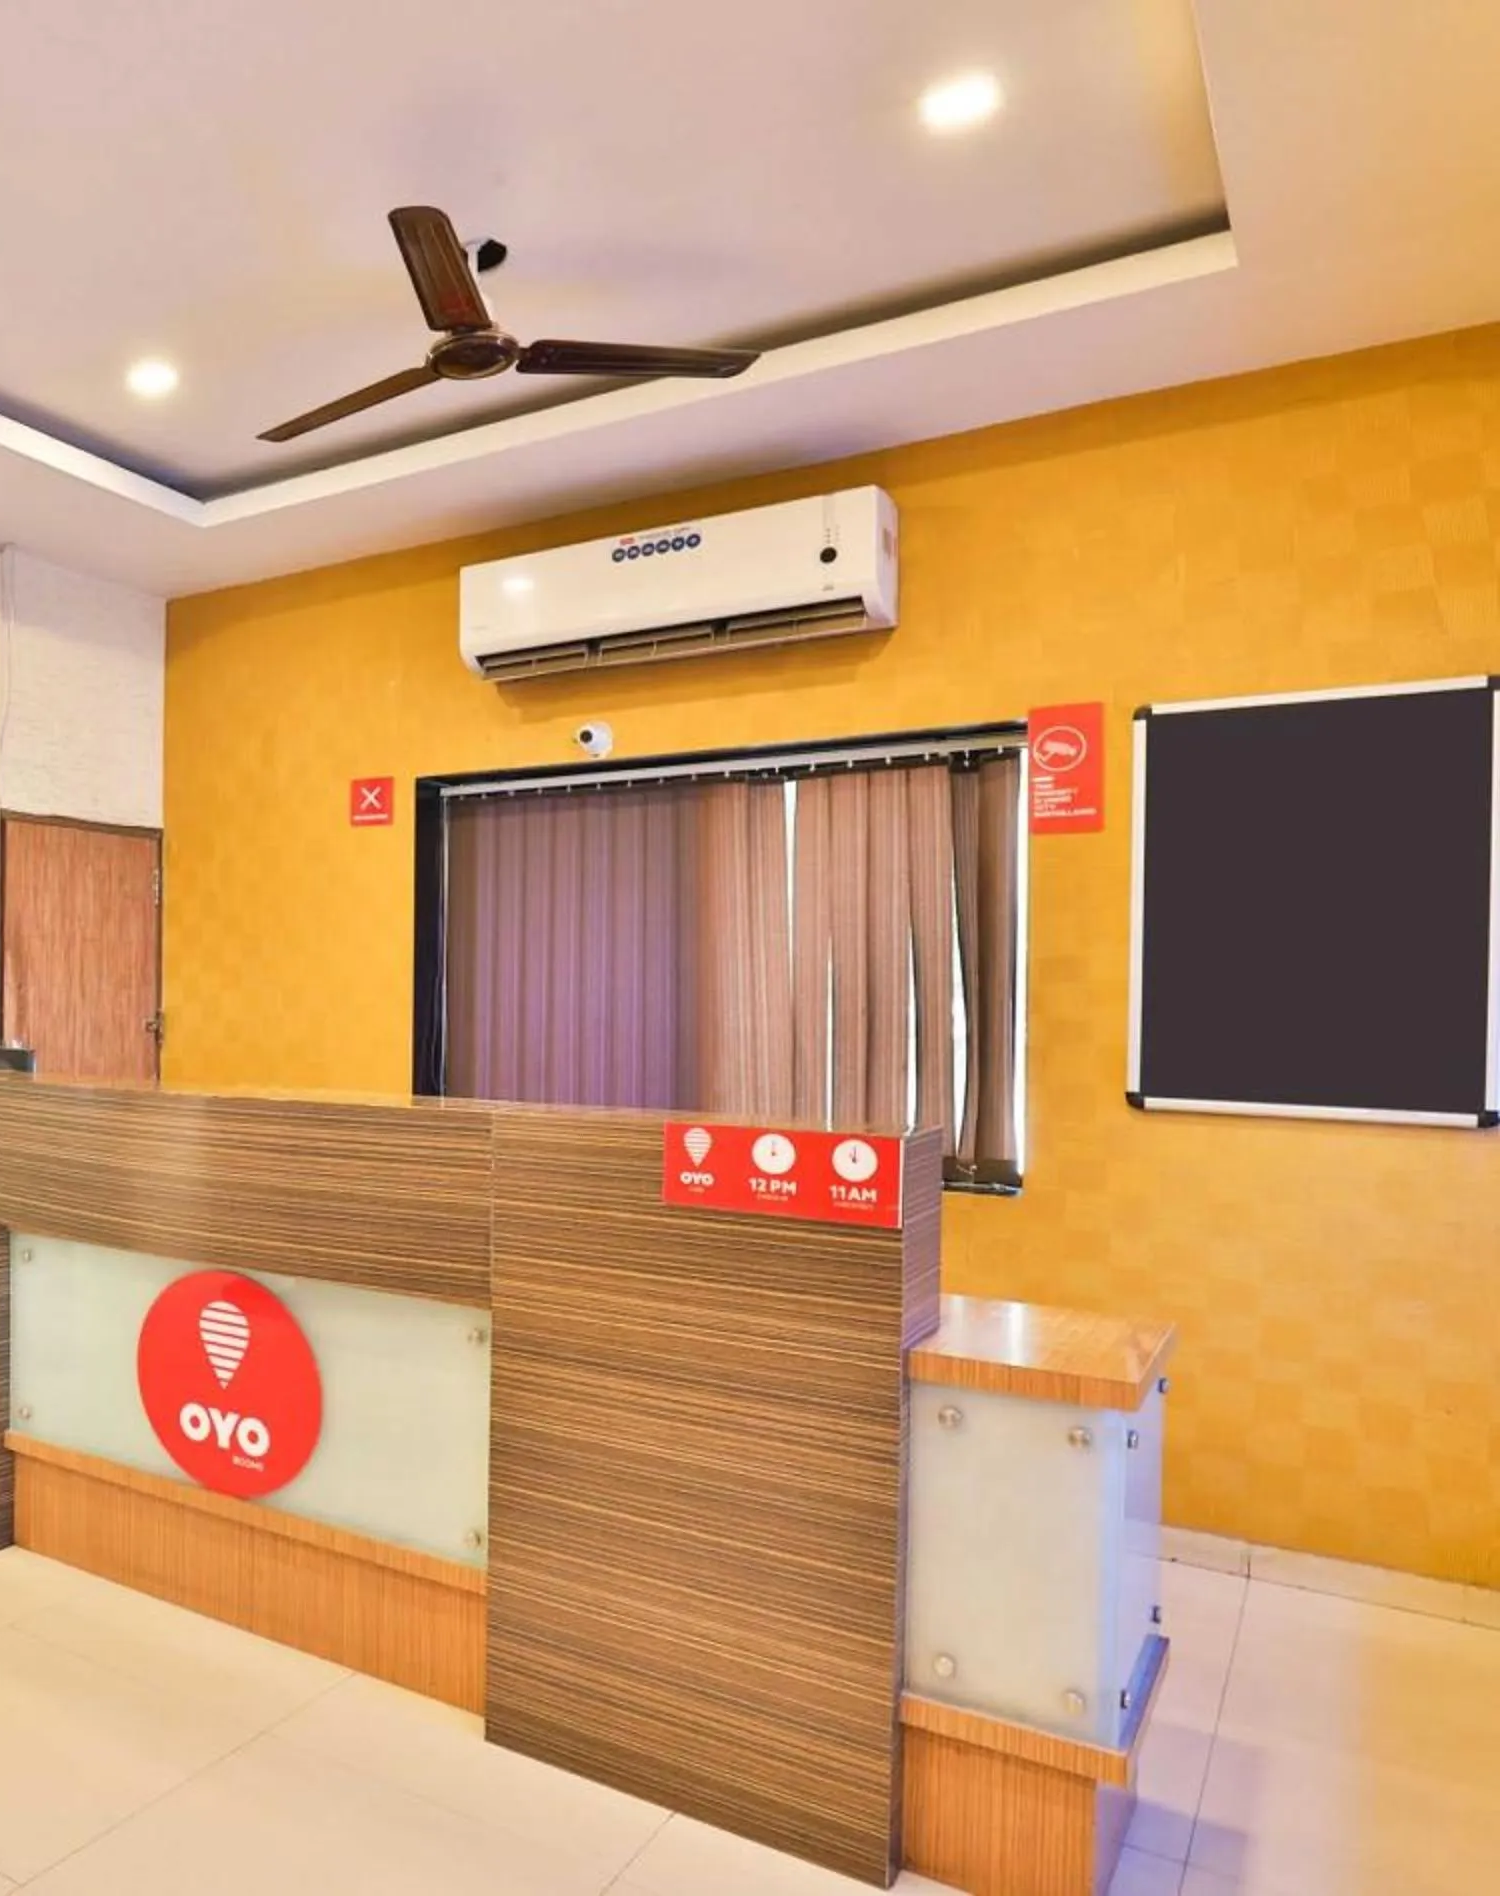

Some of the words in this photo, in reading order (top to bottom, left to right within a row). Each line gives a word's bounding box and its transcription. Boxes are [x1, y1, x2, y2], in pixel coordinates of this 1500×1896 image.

[680, 1171, 714, 1187] OYO
[748, 1177, 767, 1193] 12
[770, 1179, 797, 1196] PM
[180, 1402, 270, 1457] OYO
